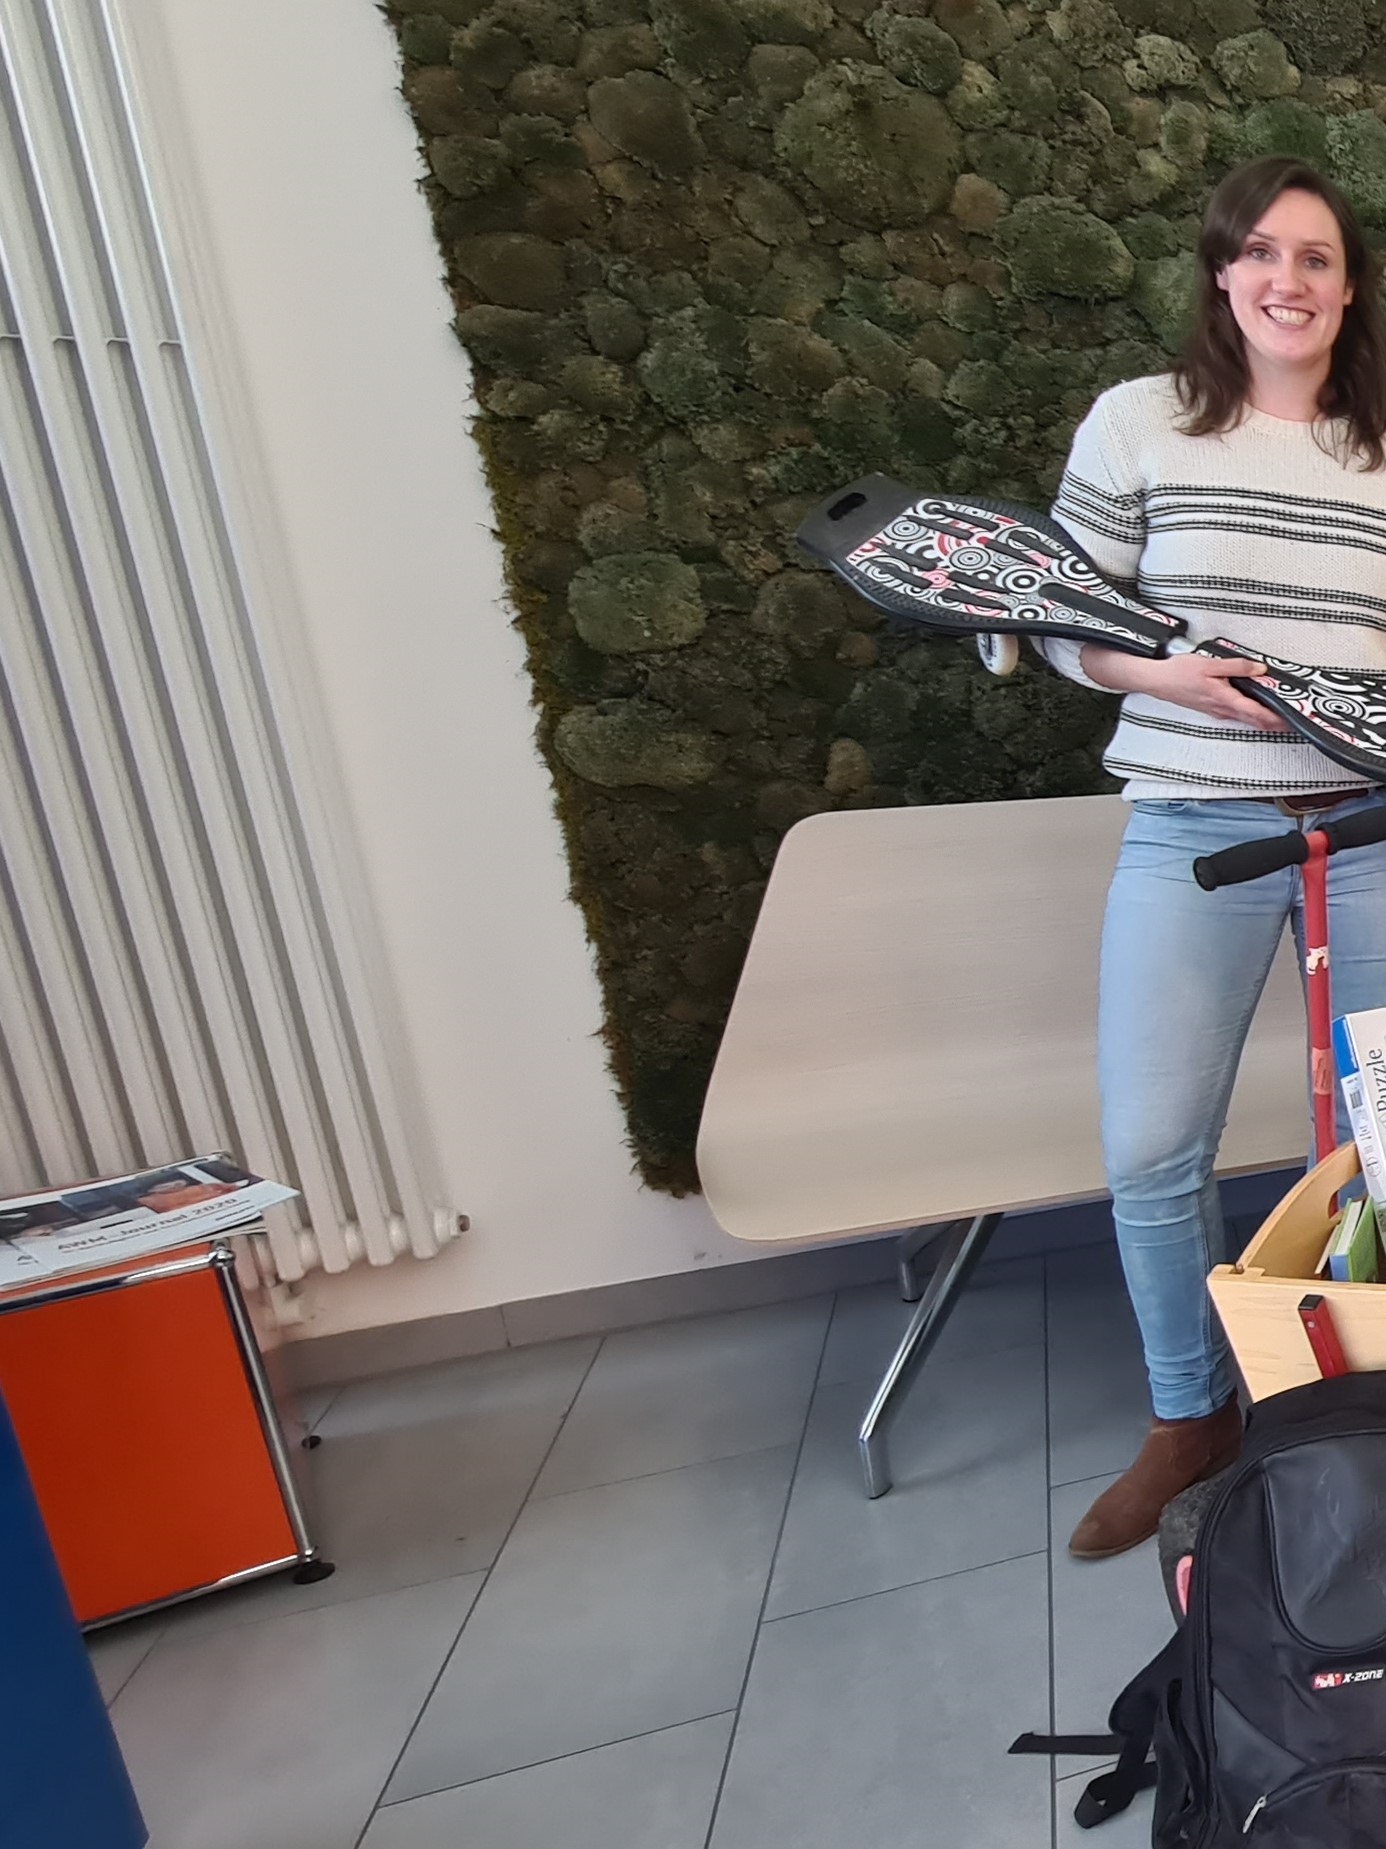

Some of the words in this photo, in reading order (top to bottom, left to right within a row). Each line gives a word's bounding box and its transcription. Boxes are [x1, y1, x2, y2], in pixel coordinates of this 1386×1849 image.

[58, 1233, 107, 1250] AWM
[120, 1213, 188, 1235] Journal
[192, 1198, 237, 1215] 2020
